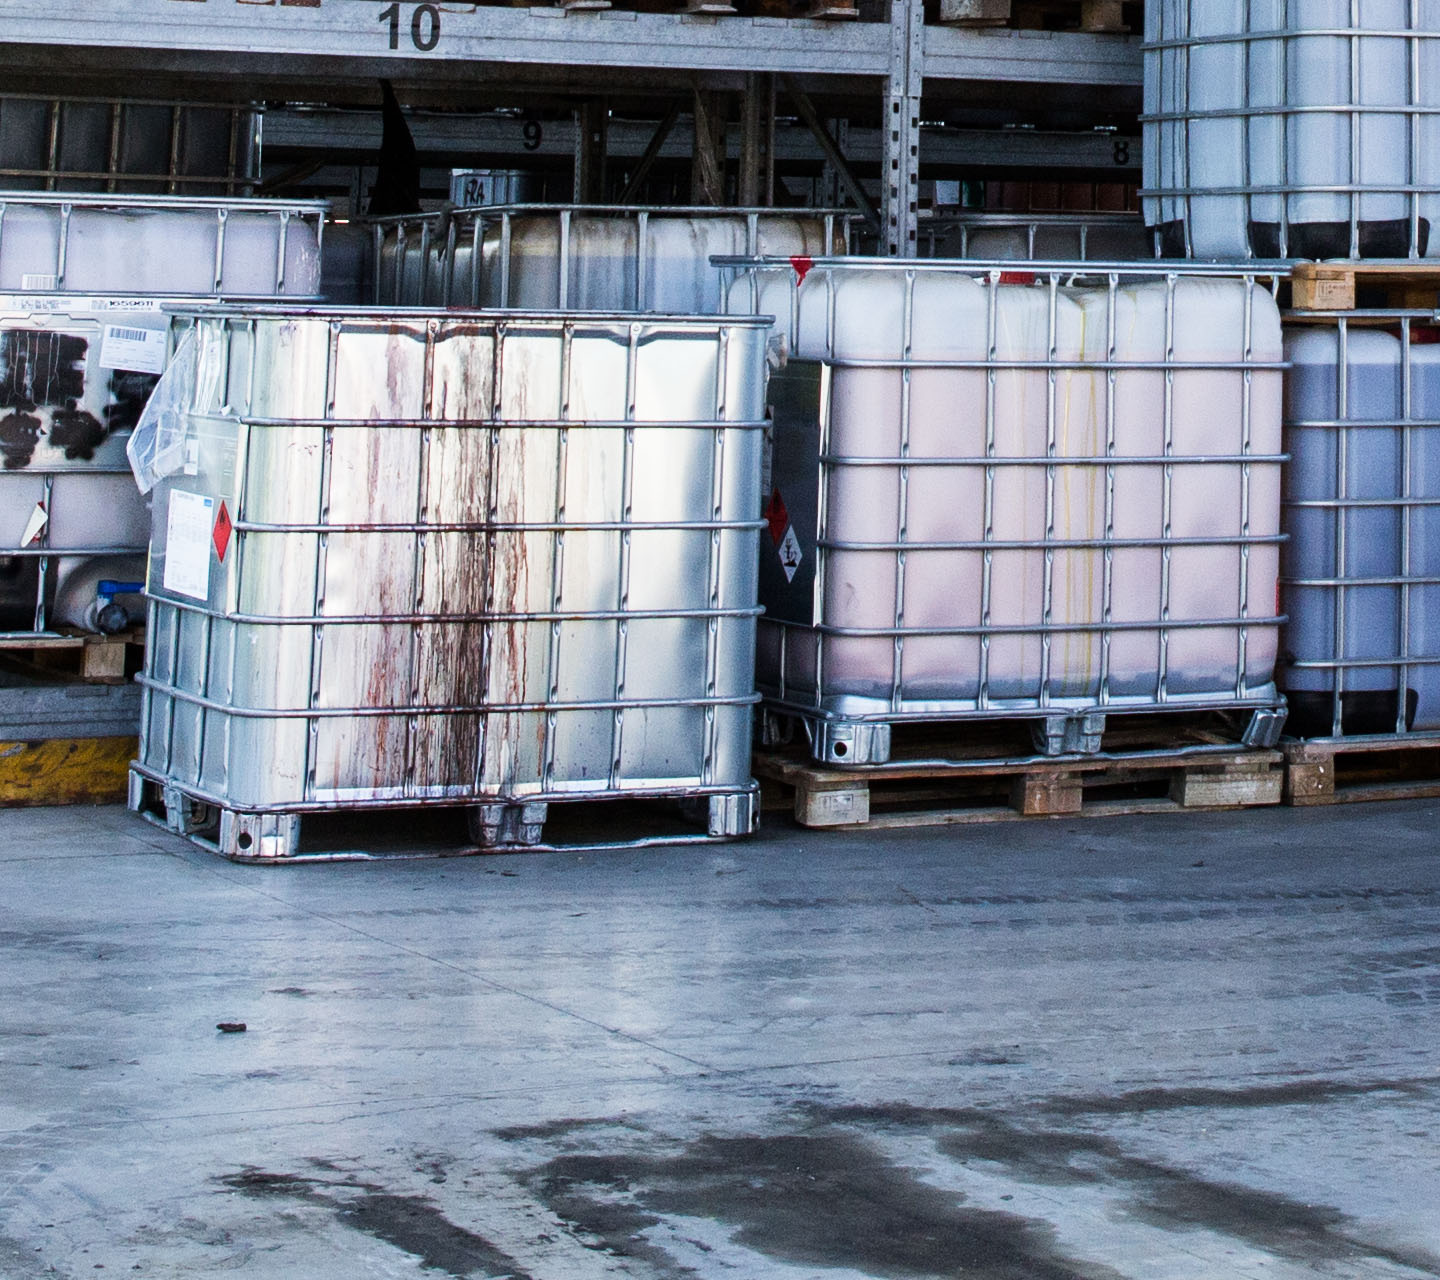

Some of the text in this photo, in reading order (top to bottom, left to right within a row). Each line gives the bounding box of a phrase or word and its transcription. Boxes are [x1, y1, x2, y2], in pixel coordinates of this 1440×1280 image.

[378, 2, 442, 52] 10
[523, 120, 543, 151] 9
[1113, 141, 1130, 166] 8
